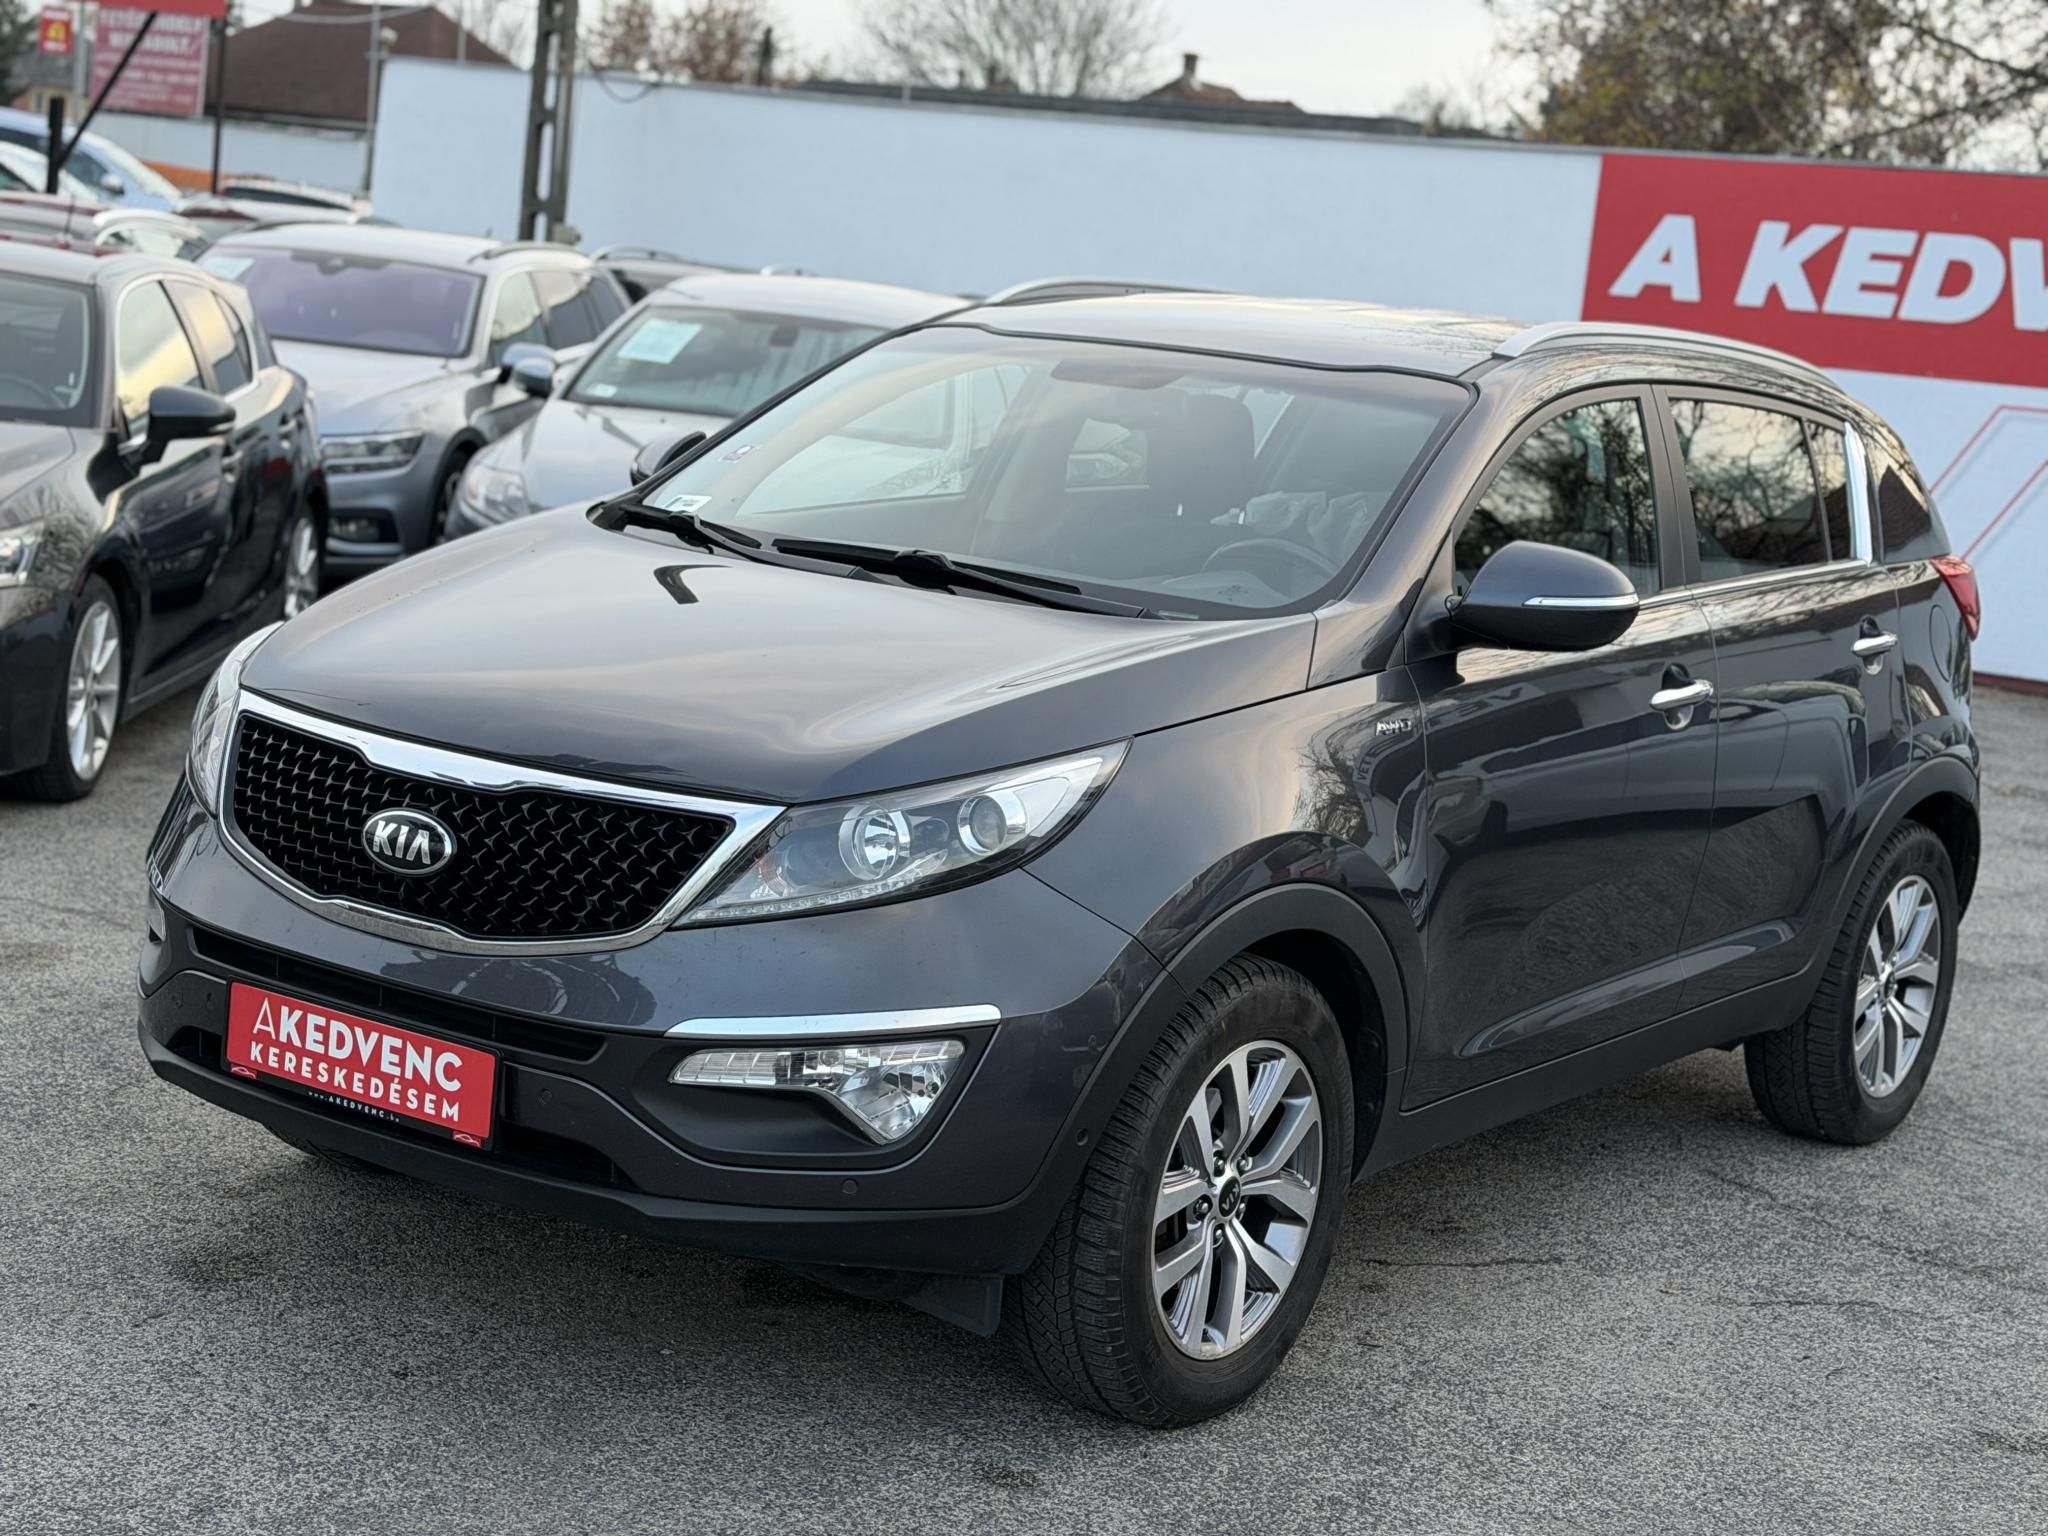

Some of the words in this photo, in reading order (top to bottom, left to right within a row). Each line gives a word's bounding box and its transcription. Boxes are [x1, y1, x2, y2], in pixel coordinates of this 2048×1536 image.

[1608, 213, 1701, 303] A
[373, 820, 431, 864] KIA
[250, 1041, 459, 1122] KERESKEDÉSEM
